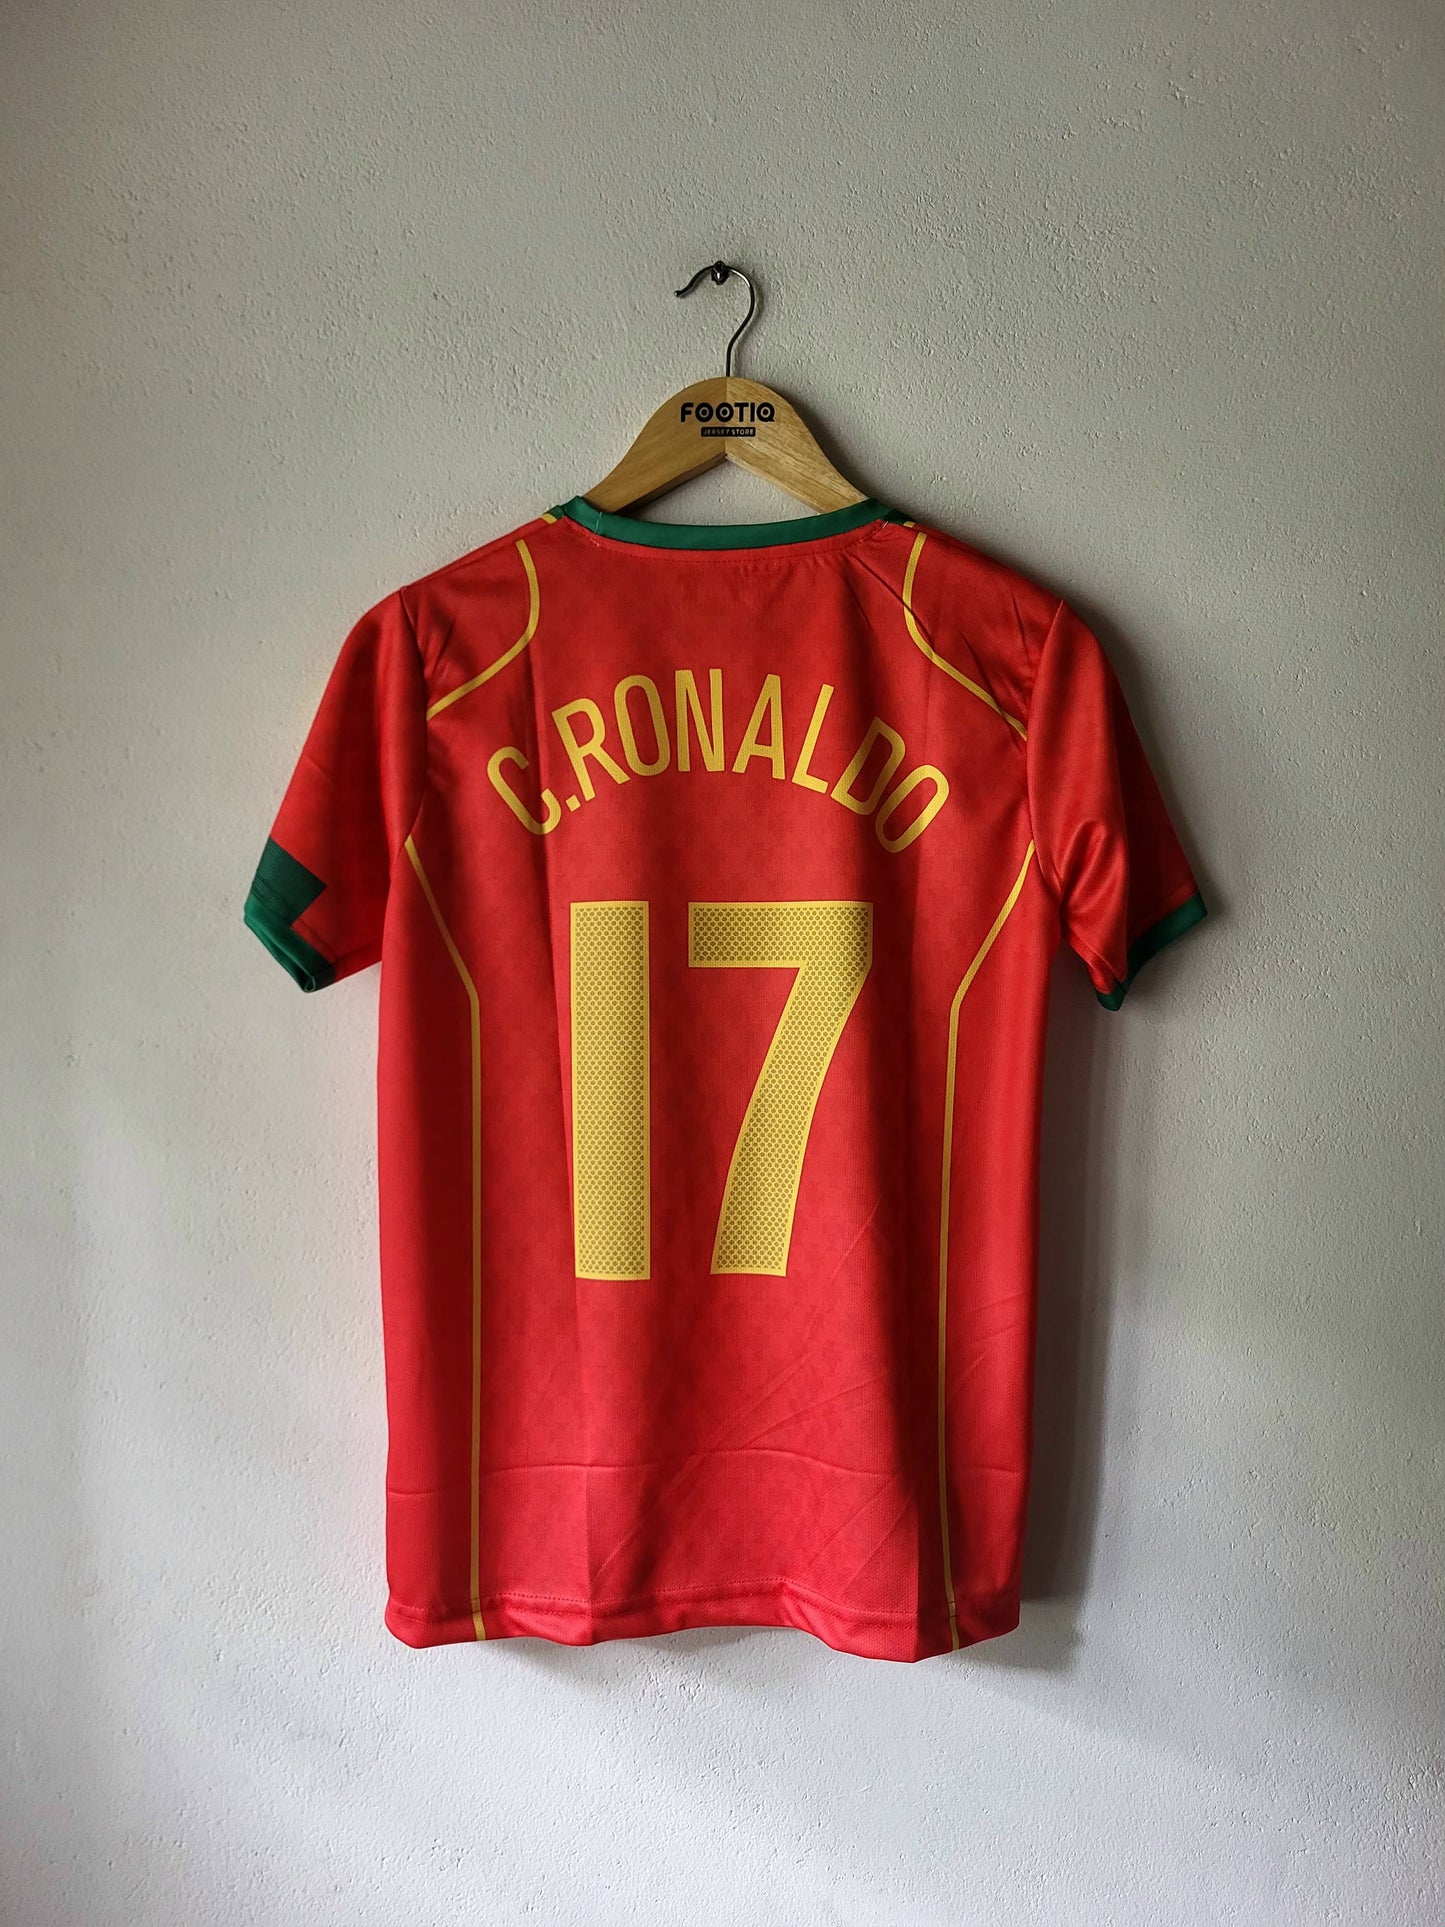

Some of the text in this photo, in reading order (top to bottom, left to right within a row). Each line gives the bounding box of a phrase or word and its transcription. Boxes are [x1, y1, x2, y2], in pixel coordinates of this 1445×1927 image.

[680, 402, 775, 423] FOOTIQ
[703, 428, 754, 436] JERSEY STORE
[487, 669, 951, 853] C.RONALDO
[570, 901, 872, 1281] 17
